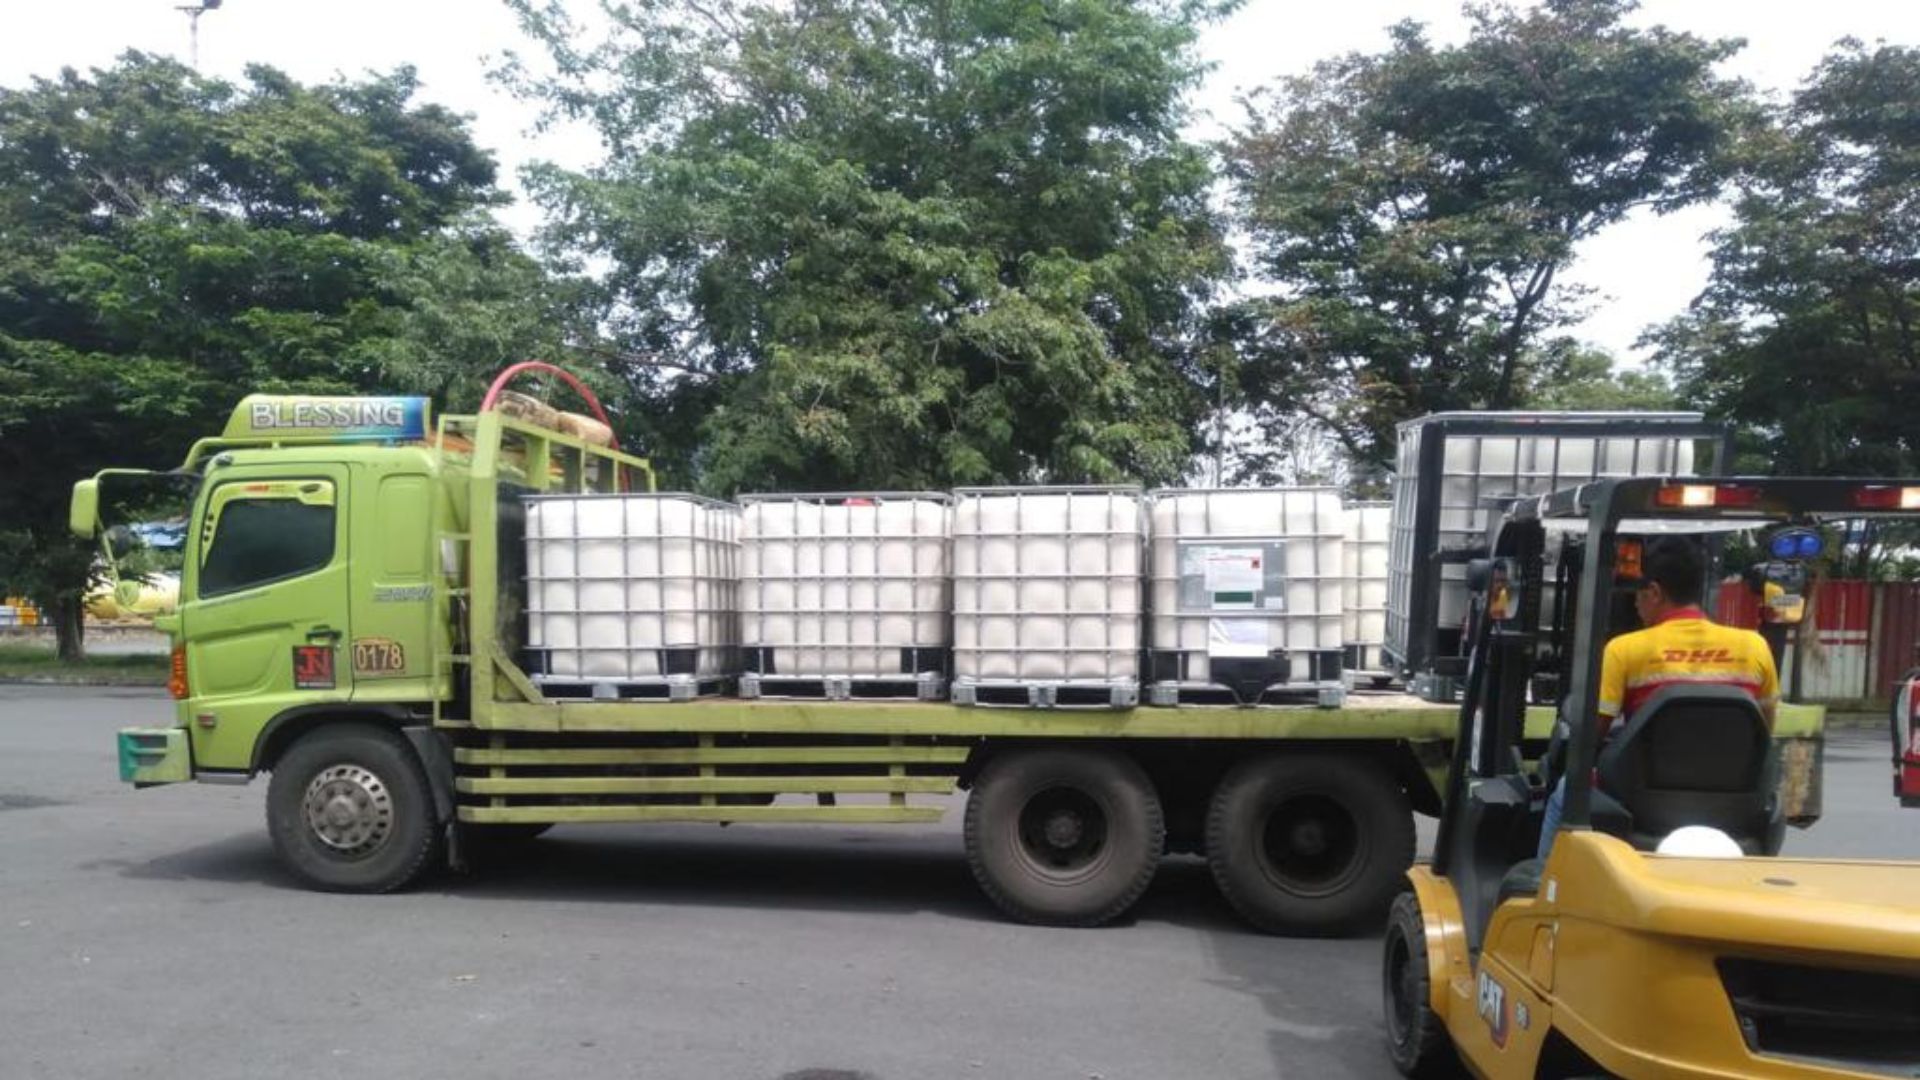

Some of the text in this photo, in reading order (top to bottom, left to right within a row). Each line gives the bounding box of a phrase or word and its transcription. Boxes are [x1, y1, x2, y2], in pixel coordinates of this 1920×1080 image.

[251, 402, 404, 429] BLESSING
[354, 645, 402, 671] 0178
[1663, 649, 1735, 663] DHL
[1480, 971, 1504, 1029] CAT
